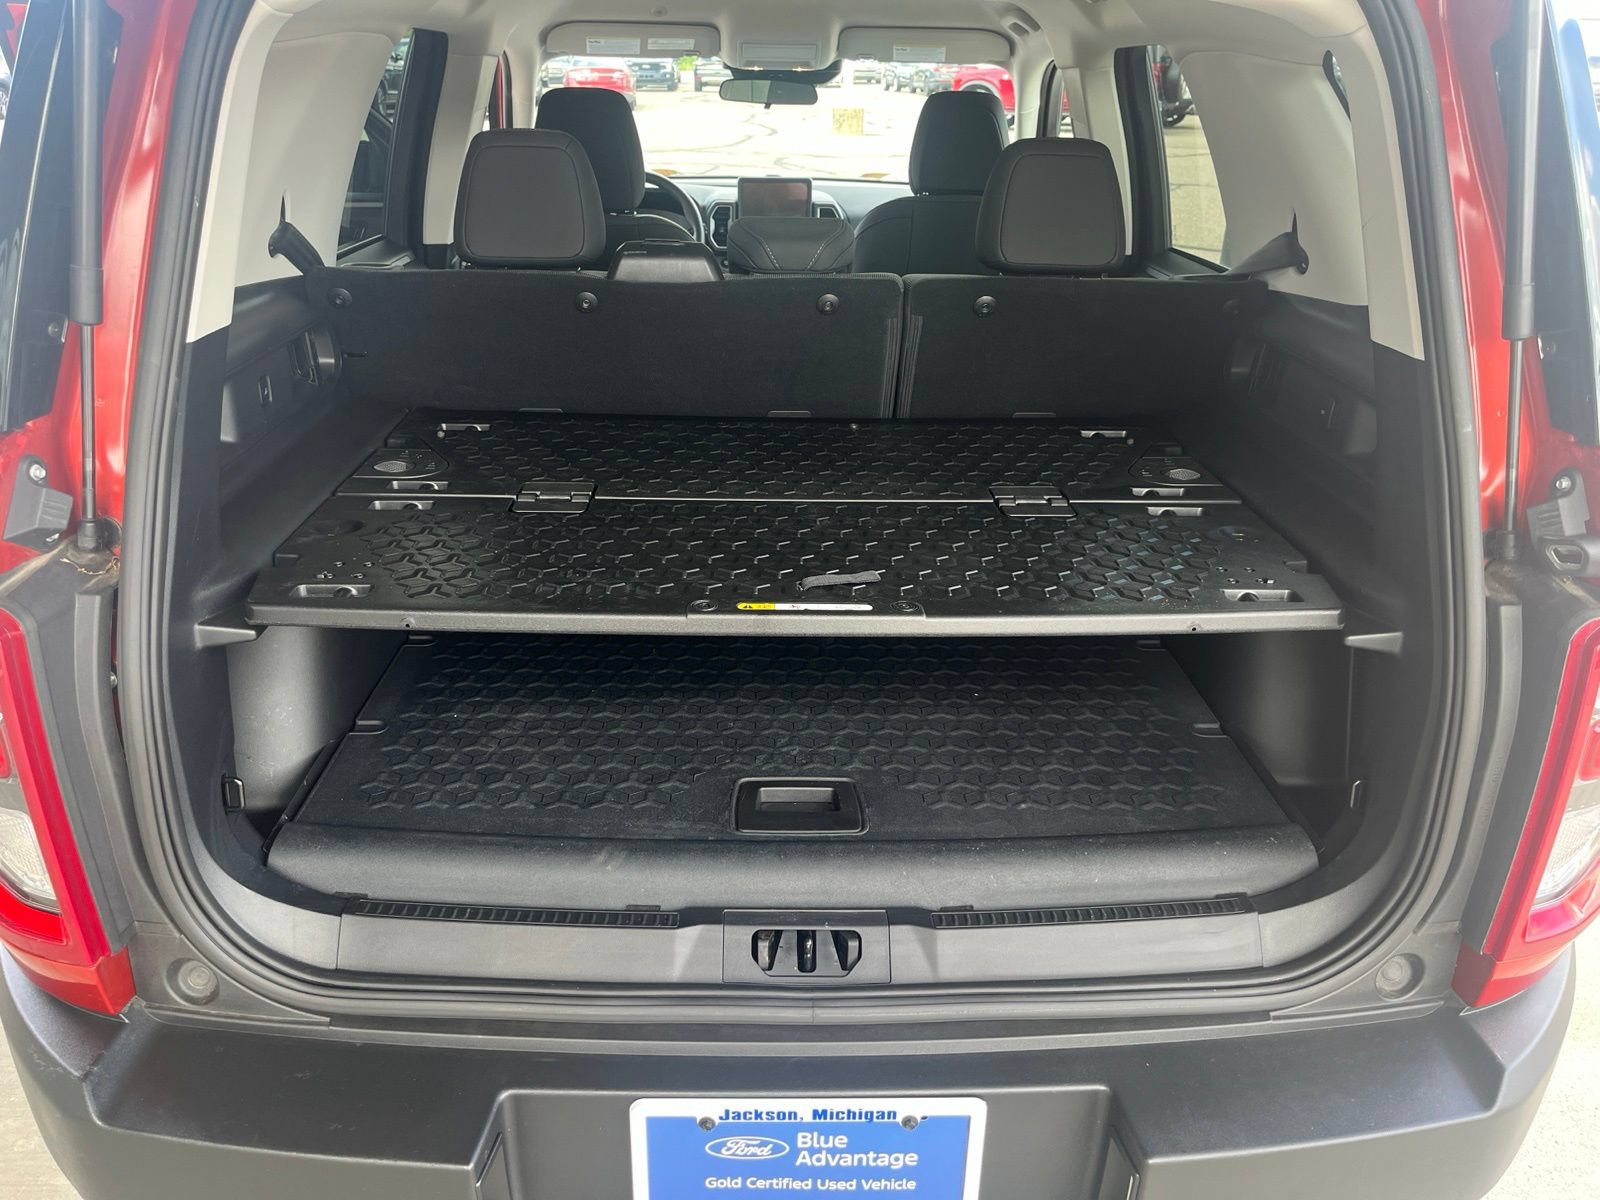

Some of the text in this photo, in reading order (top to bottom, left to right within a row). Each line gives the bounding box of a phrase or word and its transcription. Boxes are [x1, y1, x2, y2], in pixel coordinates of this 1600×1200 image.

[719, 1109, 897, 1123] Jackson, Michigan
[721, 1139, 774, 1156] Ford
[797, 1131, 848, 1148] Blue
[795, 1150, 919, 1170] Advantage
[705, 1177, 917, 1190] Gold Certified Used Vehicle
